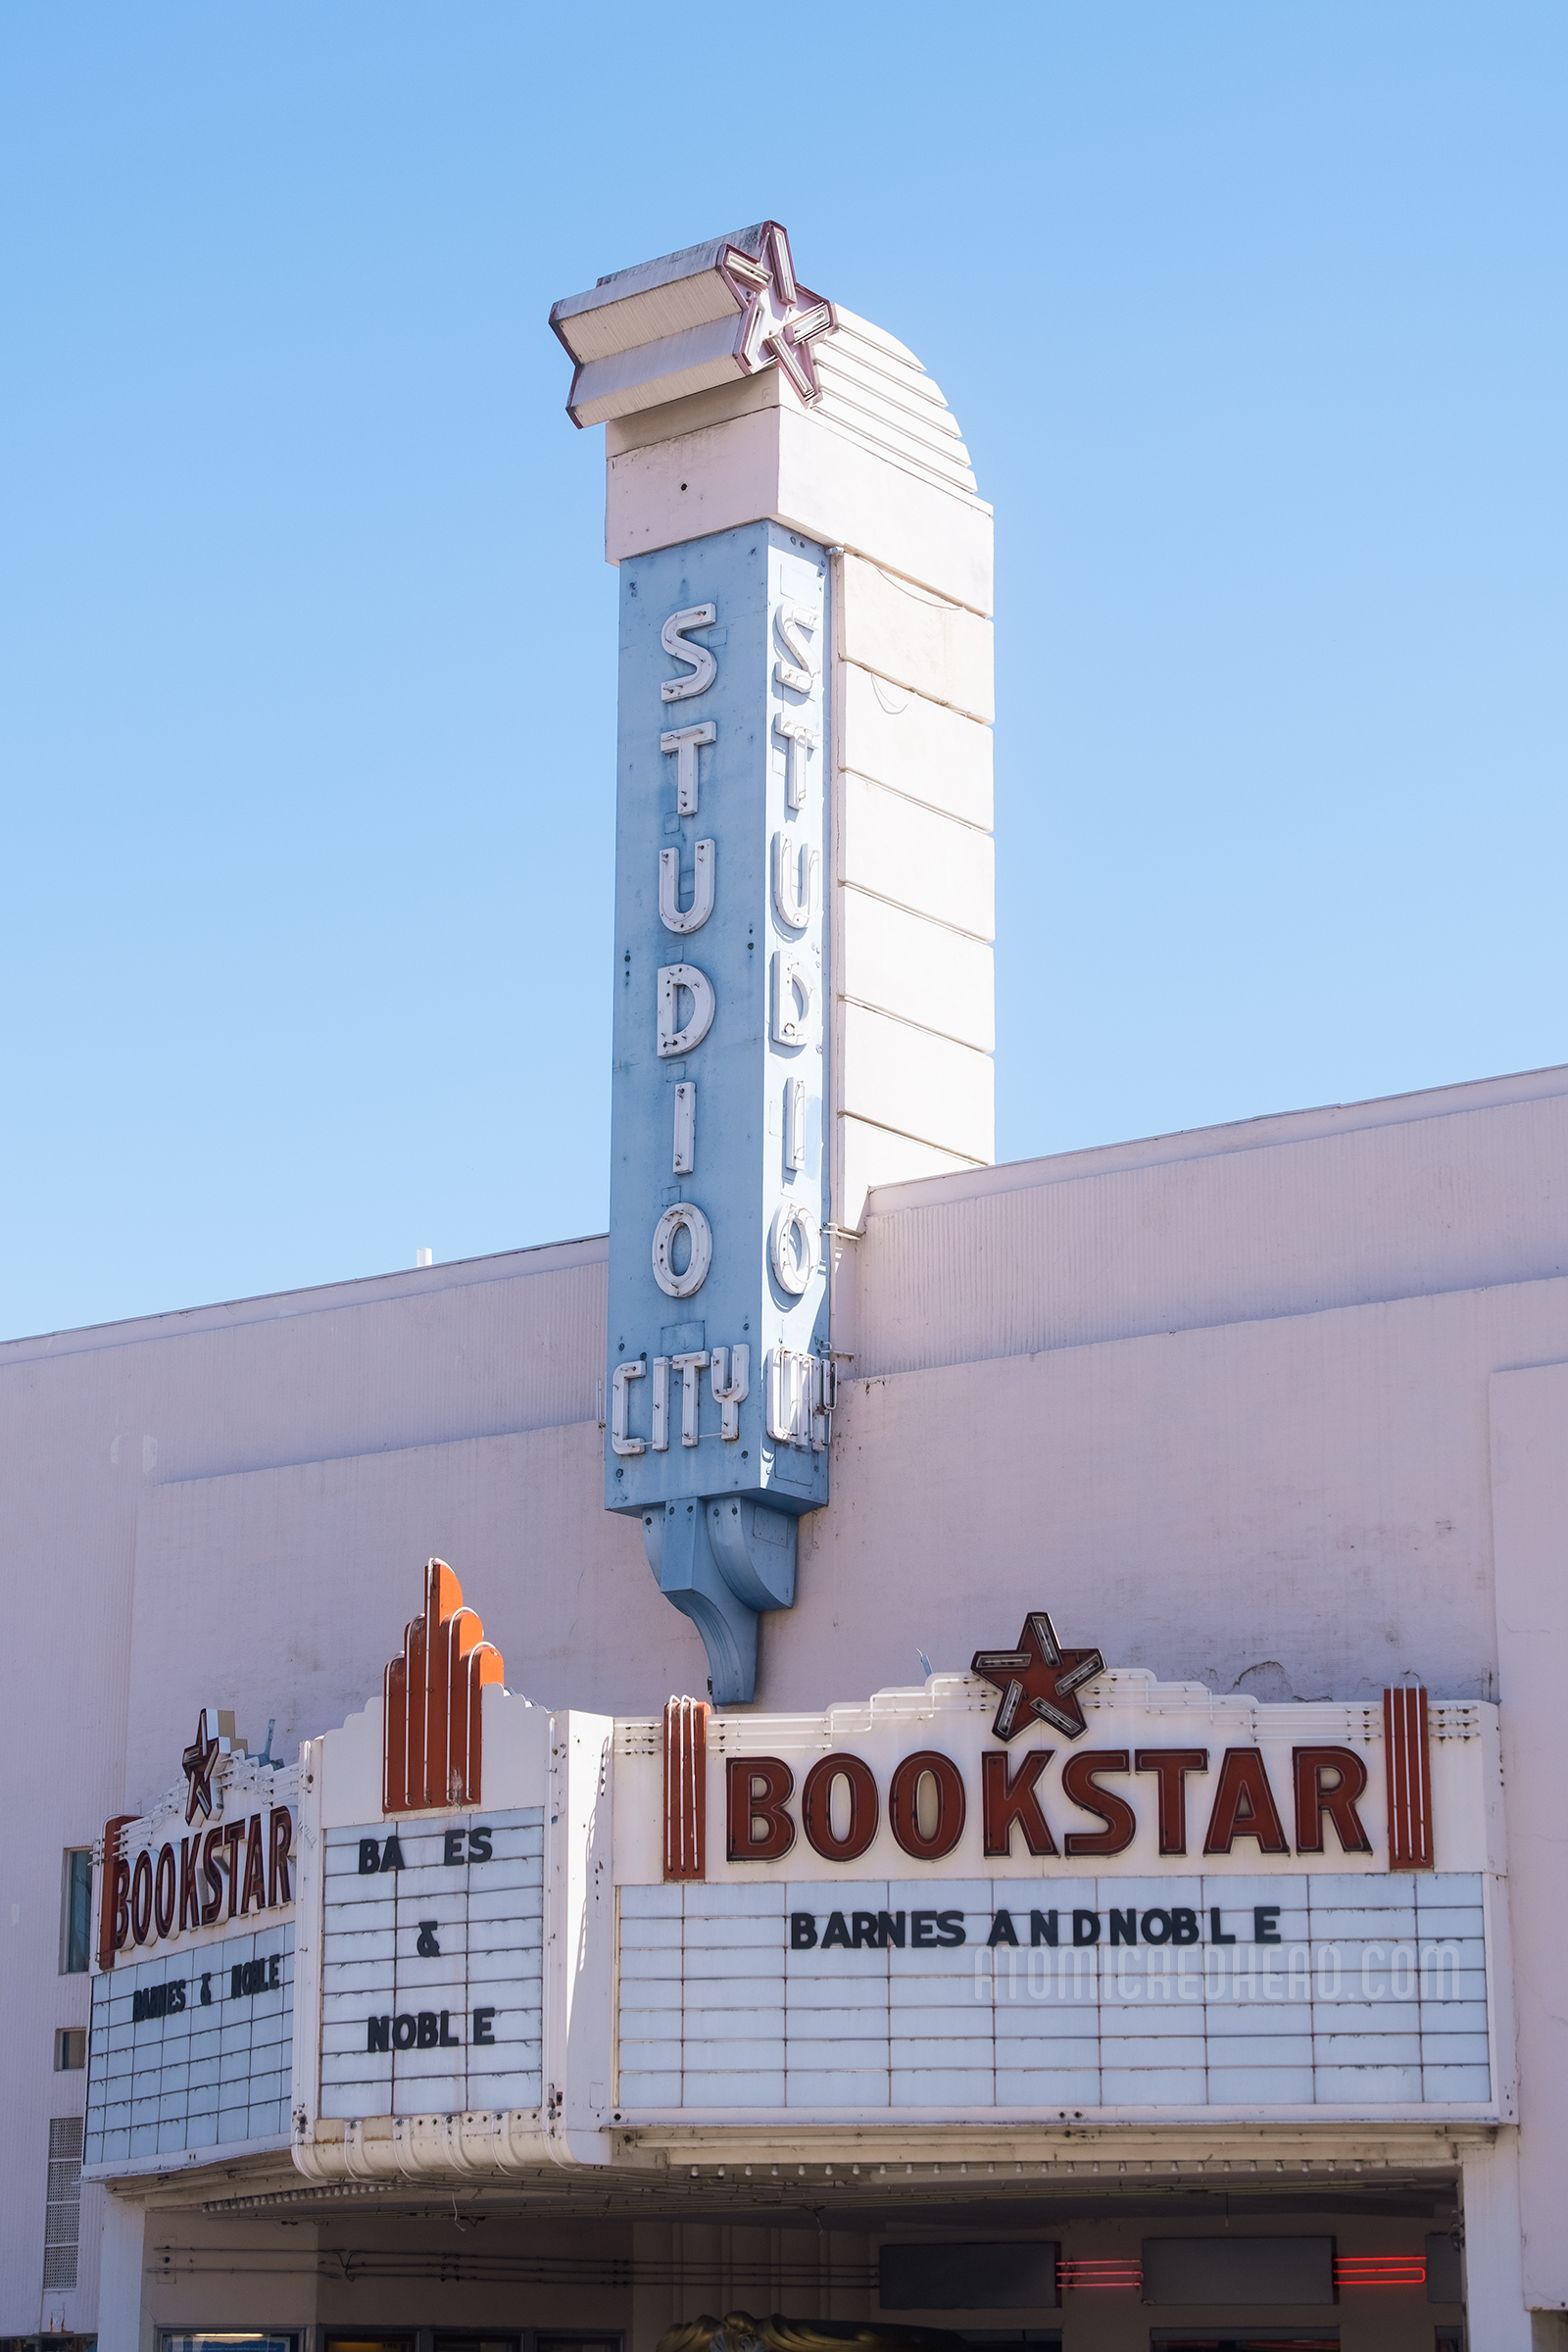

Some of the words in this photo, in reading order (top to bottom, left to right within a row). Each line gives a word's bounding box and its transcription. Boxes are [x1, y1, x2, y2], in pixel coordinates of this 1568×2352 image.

[651, 602, 717, 1298] STUDIO
[769, 599, 821, 1295] STUDIO
[612, 1344, 750, 1455] CITY
[726, 1746, 1374, 1863] BOOKSTAR
[112, 1804, 298, 1952] BOOKSTAR
[790, 1909, 967, 1951] BARNES
[986, 1909, 1102, 1947] AND
[1109, 1906, 1282, 1946] NOBLE
[132, 1979, 186, 2022] BARNES
[231, 1953, 280, 1999] NOBLE
[416, 1921, 441, 1957] &
